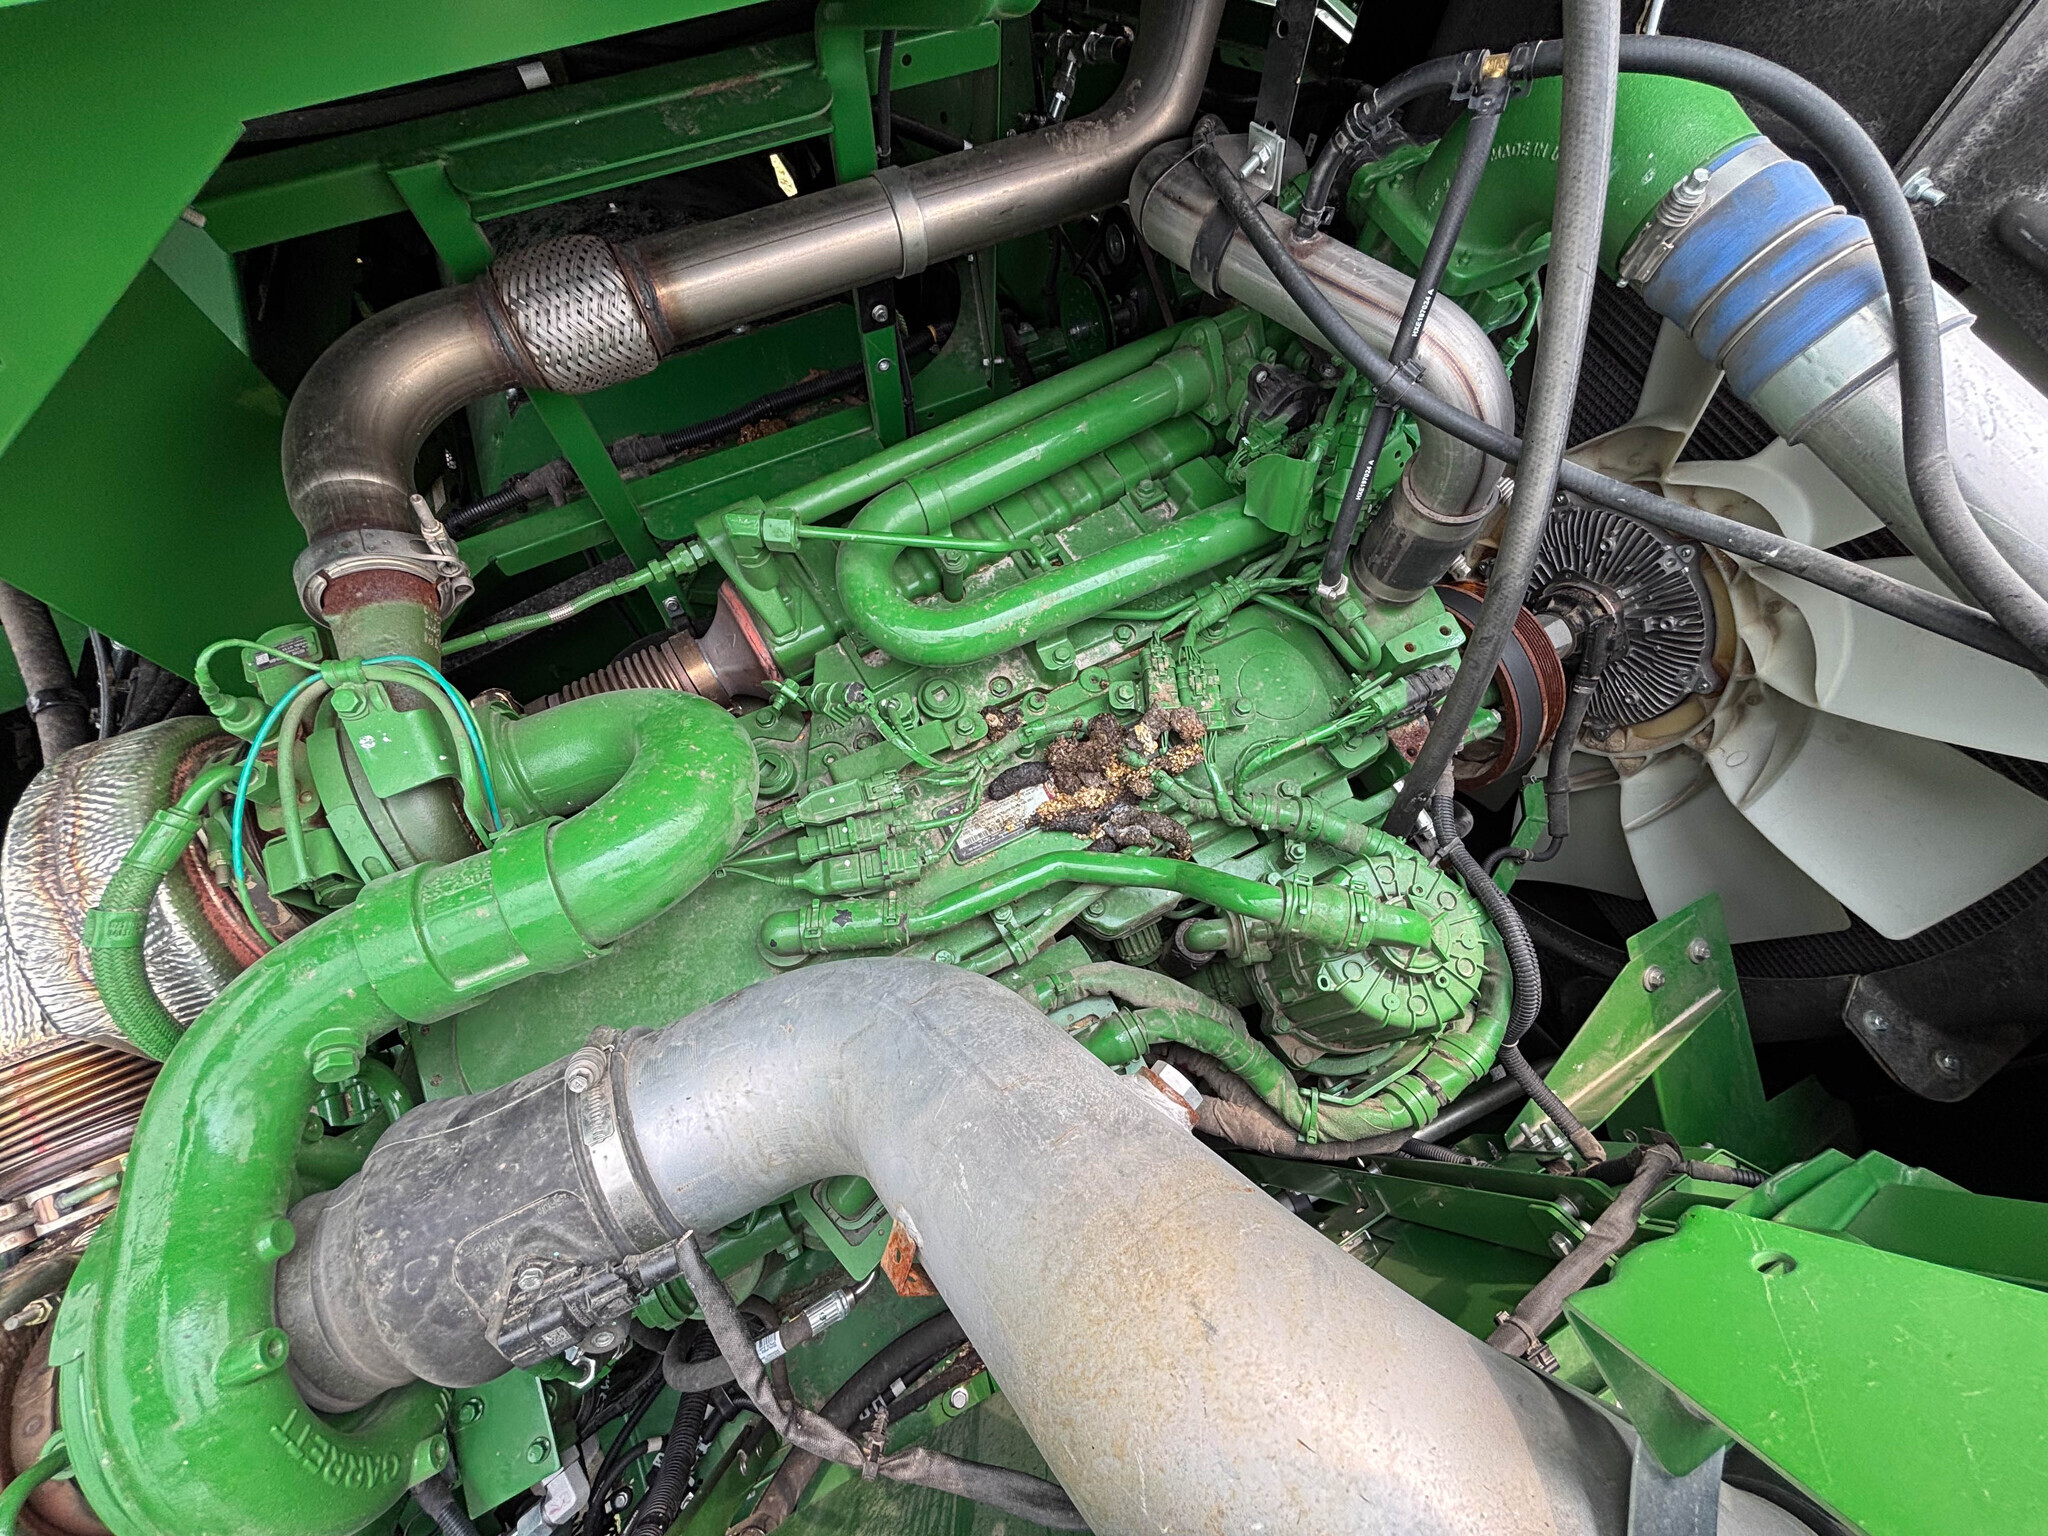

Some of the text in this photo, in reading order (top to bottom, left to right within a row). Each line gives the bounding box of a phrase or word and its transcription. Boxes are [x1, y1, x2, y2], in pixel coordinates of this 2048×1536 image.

[1490, 141, 1531, 162] MADE
[1532, 141, 1549, 158] IN
[1427, 288, 1435, 296] A
[269, 1408, 399, 1490] GARRETT
